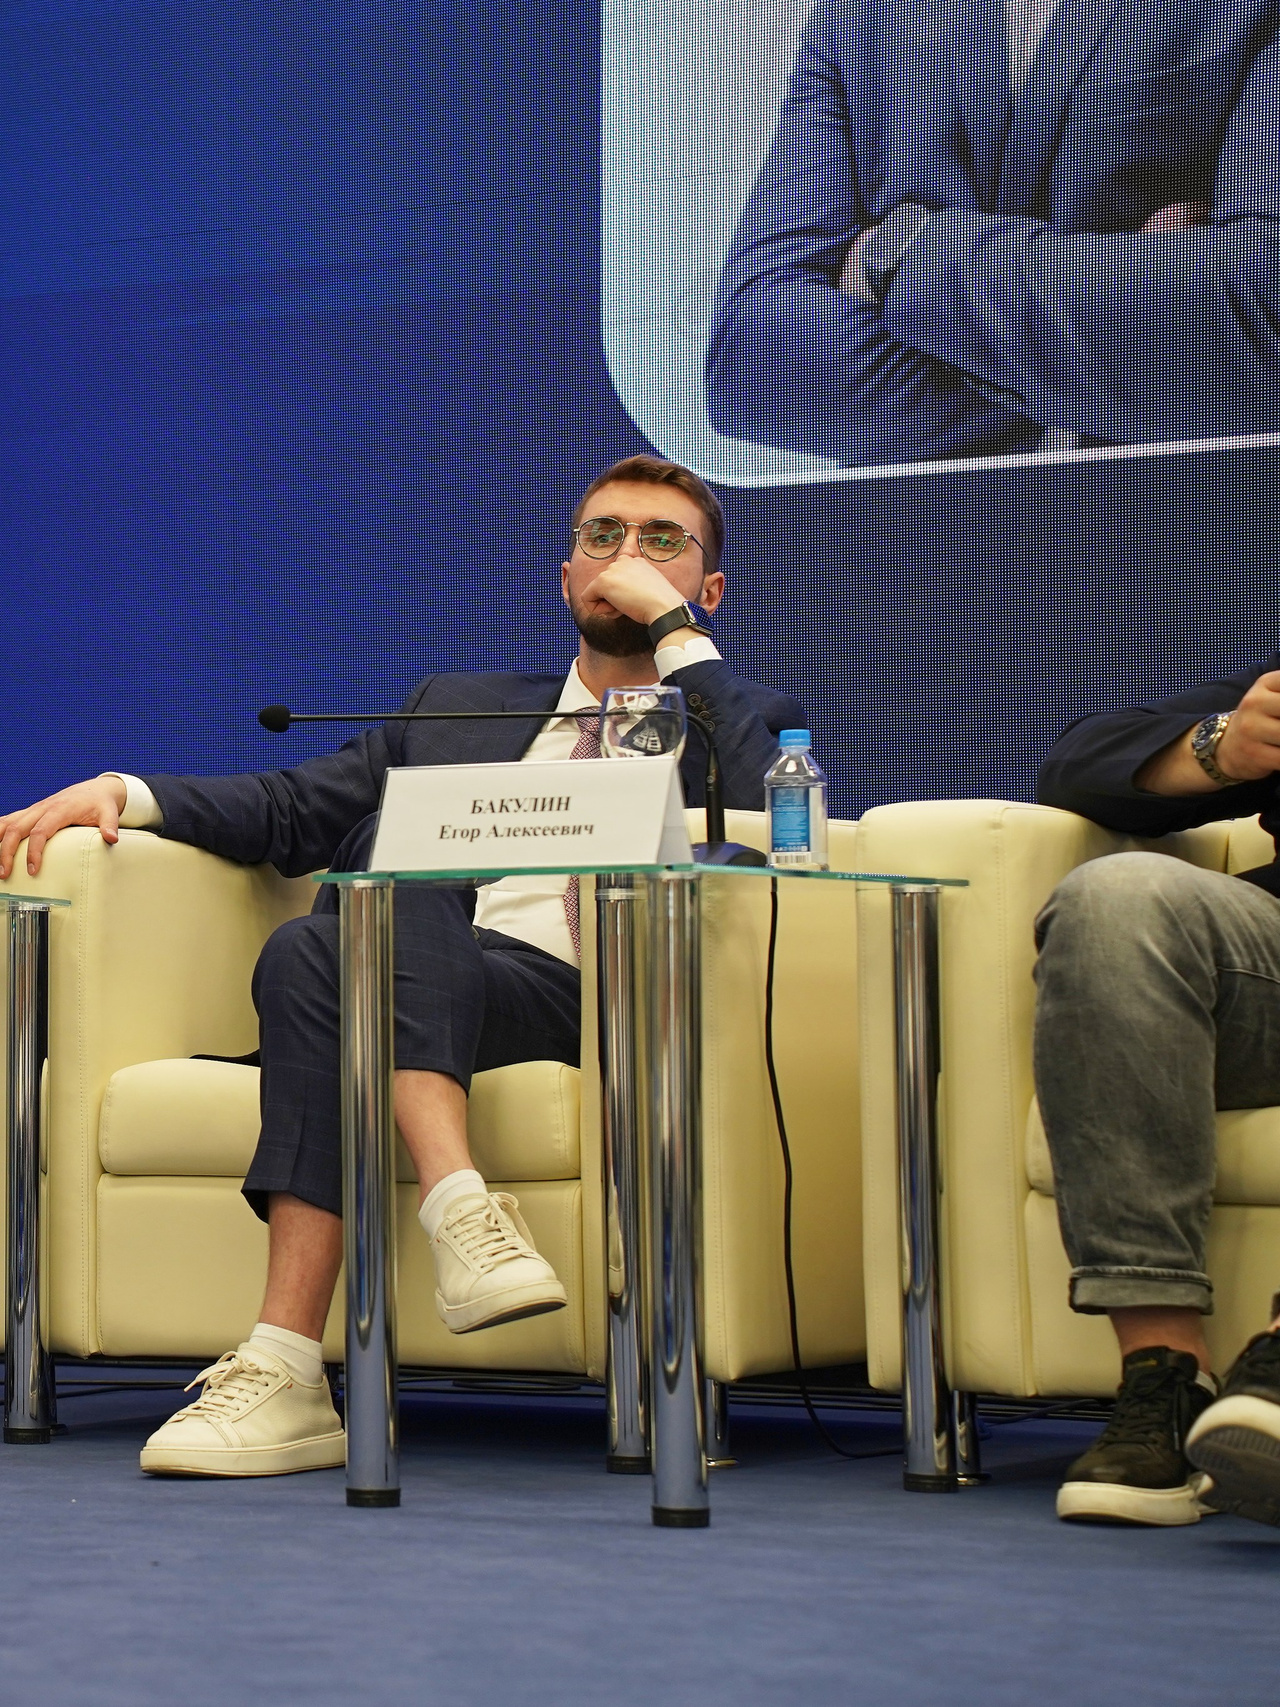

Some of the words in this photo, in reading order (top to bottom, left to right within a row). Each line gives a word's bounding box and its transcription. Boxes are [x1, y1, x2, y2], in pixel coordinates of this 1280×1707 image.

[470, 796, 572, 815] БАКУЛИН
[438, 825, 482, 843] Егор
[486, 824, 595, 839] Алексеевич
